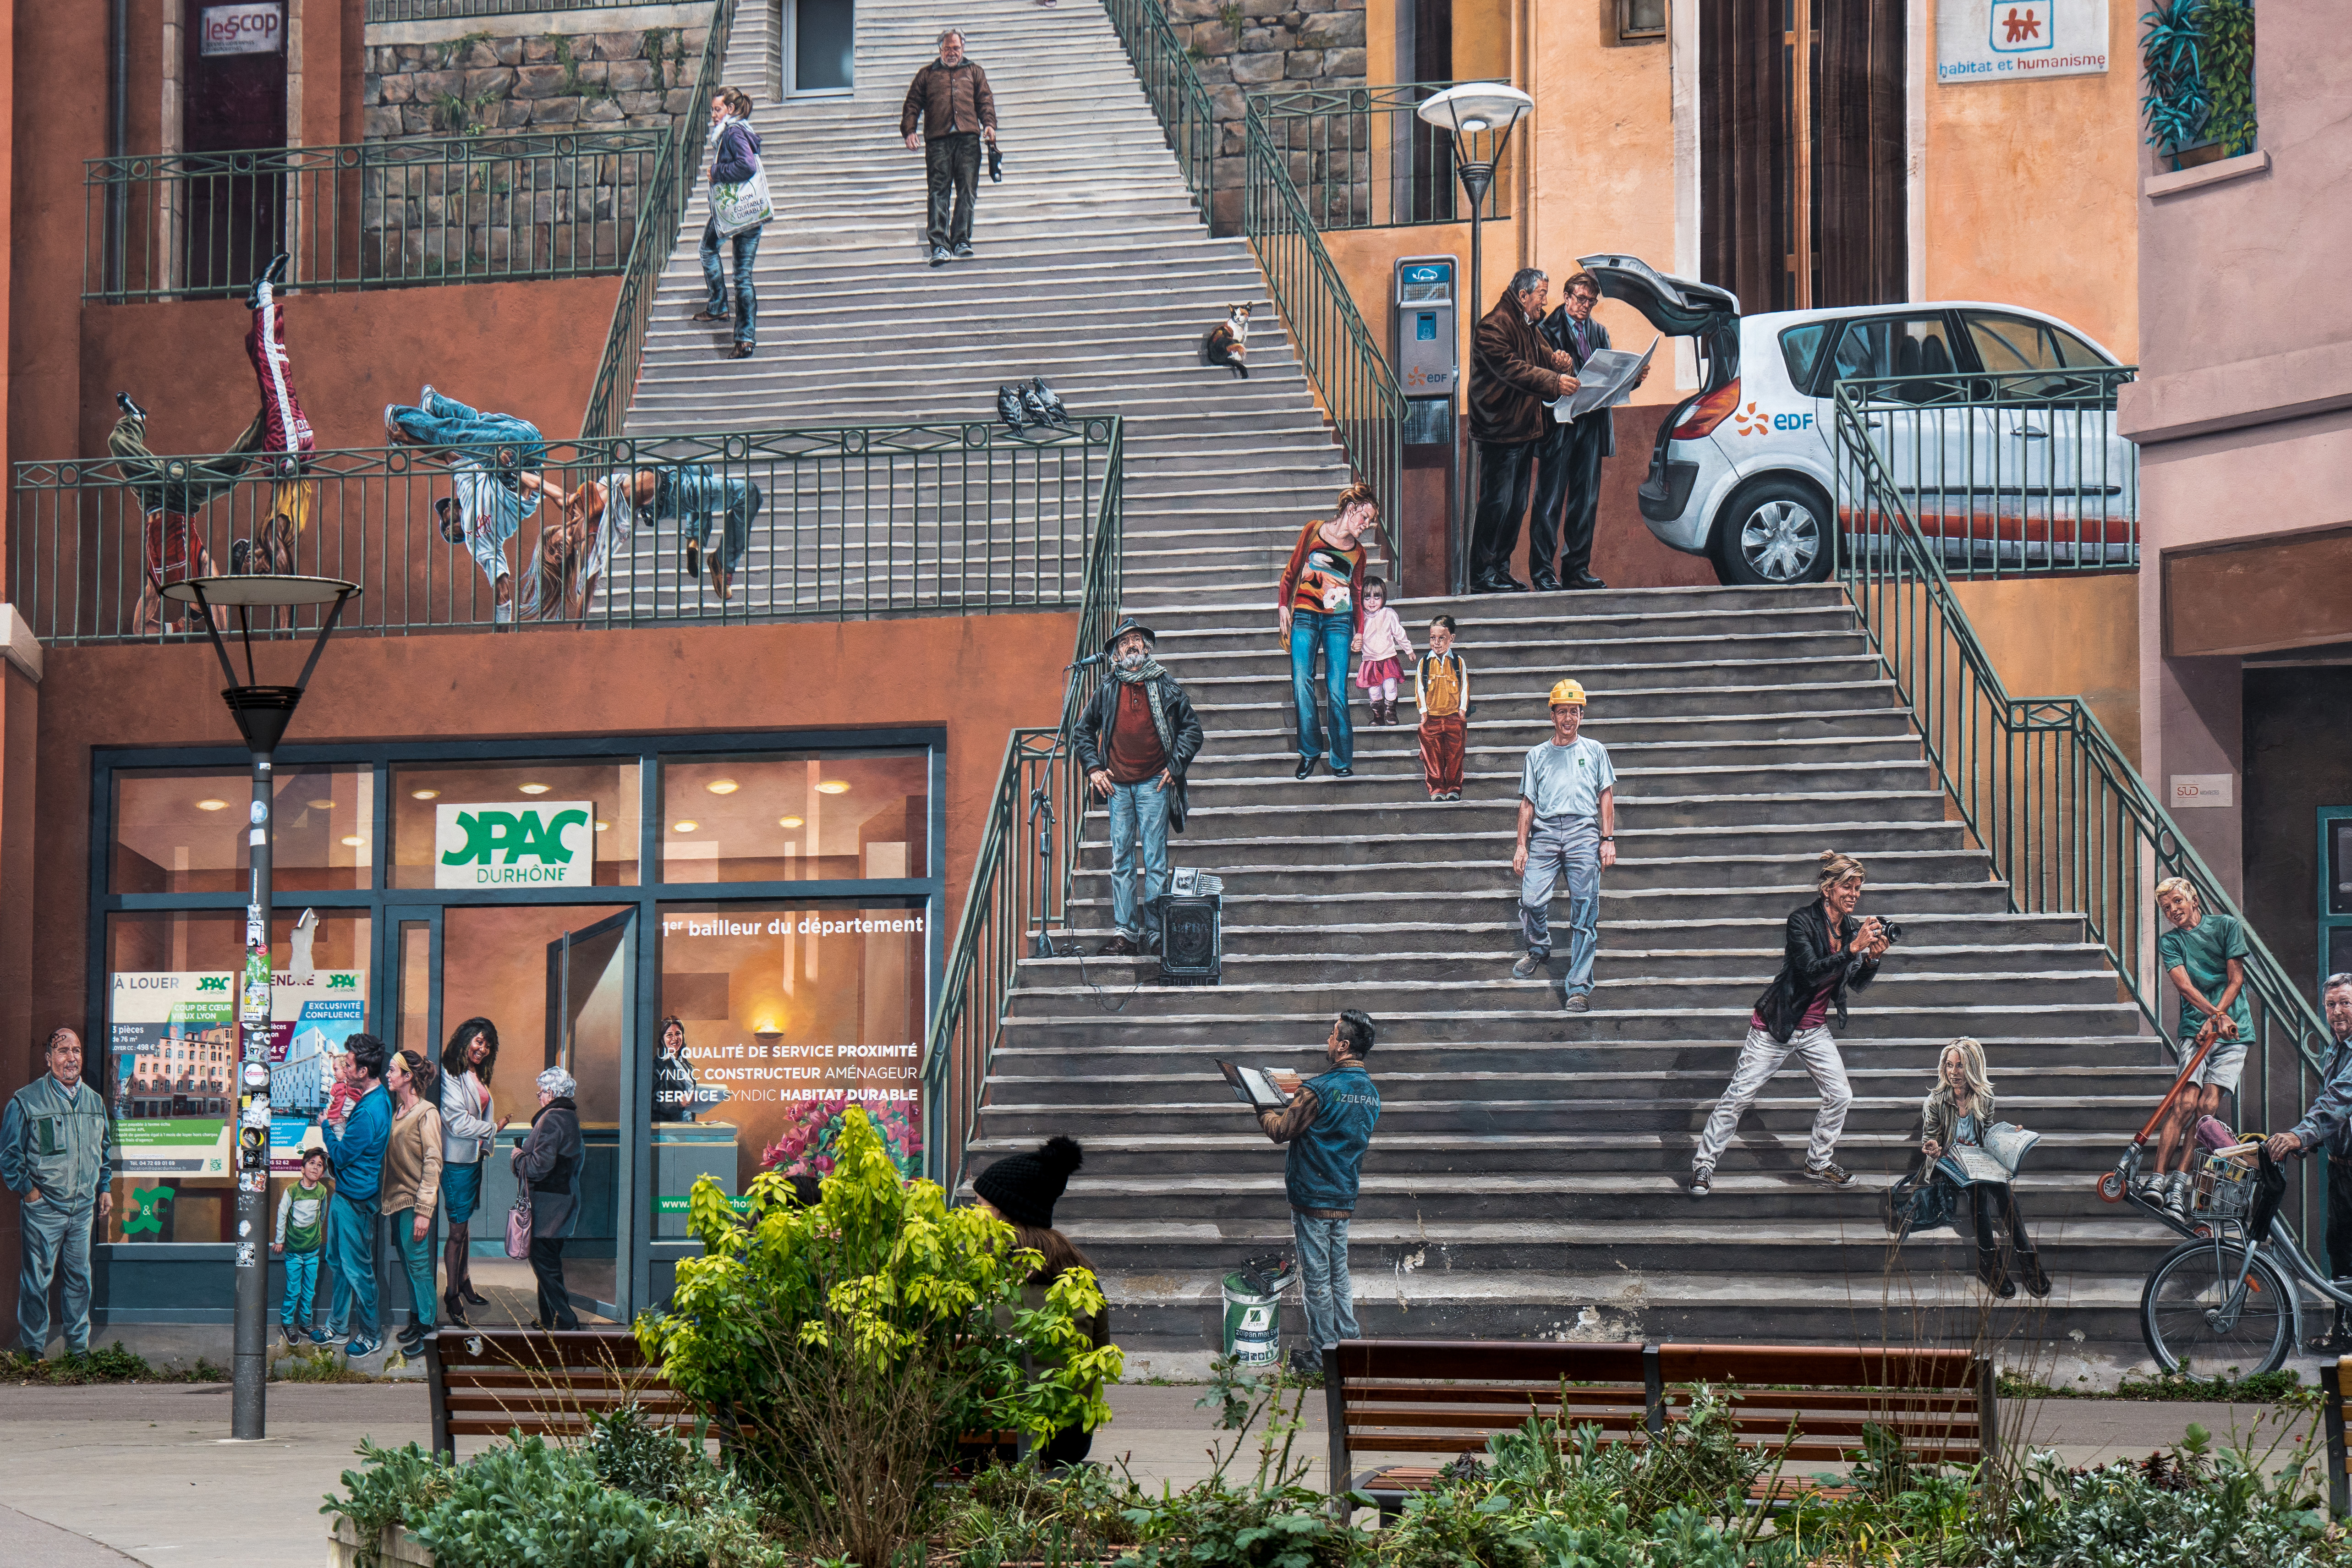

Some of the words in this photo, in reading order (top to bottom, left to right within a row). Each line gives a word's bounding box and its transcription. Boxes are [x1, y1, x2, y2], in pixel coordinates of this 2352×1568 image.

[1939, 60, 1992, 76] habitat
[1998, 59, 2013, 71] et
[2018, 54, 2105, 70] humanisme
[740, 193, 753, 202] LYON
[737, 206, 764, 219] DURABLE
[2177, 786, 2198, 796] SUD
[477, 864, 567, 883] DURHÔNE
[689, 919, 761, 936] bailleur
[768, 918, 791, 935] du
[798, 917, 923, 937] département
[114, 975, 124, 989] À
[130, 977, 179, 989] LOUER
[309, 1001, 361, 1010] EXCLUSIVITÉ
[119, 1025, 144, 1035] pièces
[681, 1044, 744, 1059] QUALITÉ
[748, 1046, 768, 1058] DE
[772, 1045, 833, 1058] SERVICE
[838, 1042, 917, 1058] PROXIMITÉ
[657, 1069, 701, 1080] YNDIC
[704, 1067, 820, 1080] CONSTRUCTEUR
[825, 1064, 917, 1079] AMÉNAGEUR
[656, 1090, 718, 1102] SERVICE
[723, 1089, 776, 1102] SYNDIC
[780, 1089, 844, 1101] HABITAT
[847, 1089, 918, 1101] DURABLE
[1340, 1093, 1379, 1107] ZOLPAN
[143, 1205, 151, 1216] &
